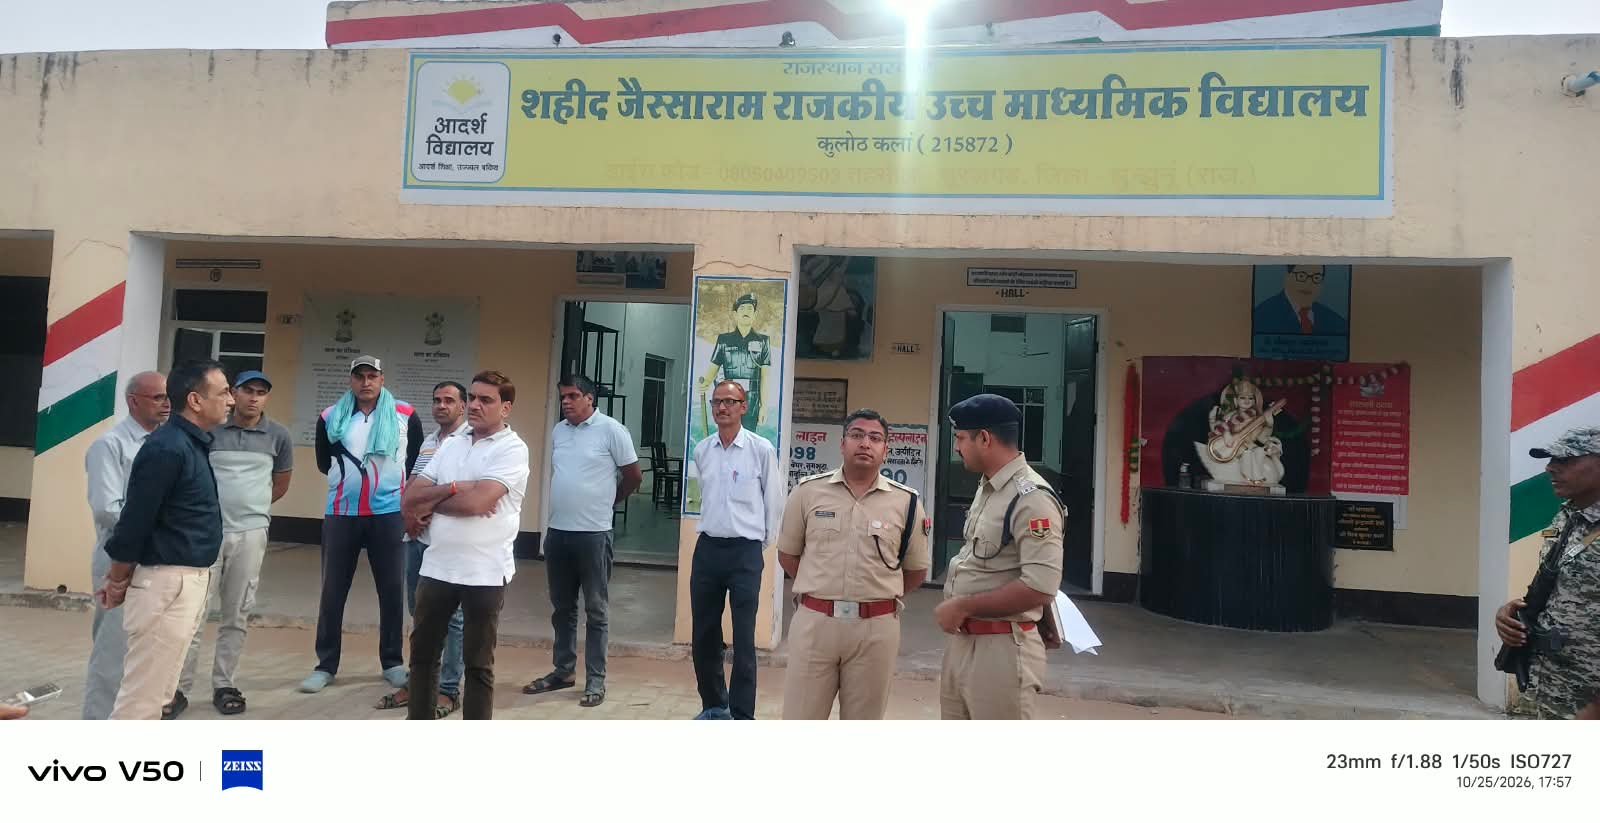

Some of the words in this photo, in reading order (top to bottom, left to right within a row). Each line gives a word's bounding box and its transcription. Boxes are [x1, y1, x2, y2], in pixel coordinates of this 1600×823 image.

[782, 61, 863, 76] राजस्थान
[520, 77, 611, 125] शहीद
[616, 76, 767, 122] जैस्साराम
[772, 78, 917, 122] राजकीय
[925, 90, 997, 122] उच्च
[1003, 73, 1191, 121] माध्यमिक
[1197, 71, 1370, 119] विद्यालय
[433, 113, 488, 135] आदर्श
[425, 133, 495, 156] विद्यालय
[816, 130, 869, 158] कुलोठ
[931, 136, 999, 154] 215872
[790, 446, 816, 461] 98
